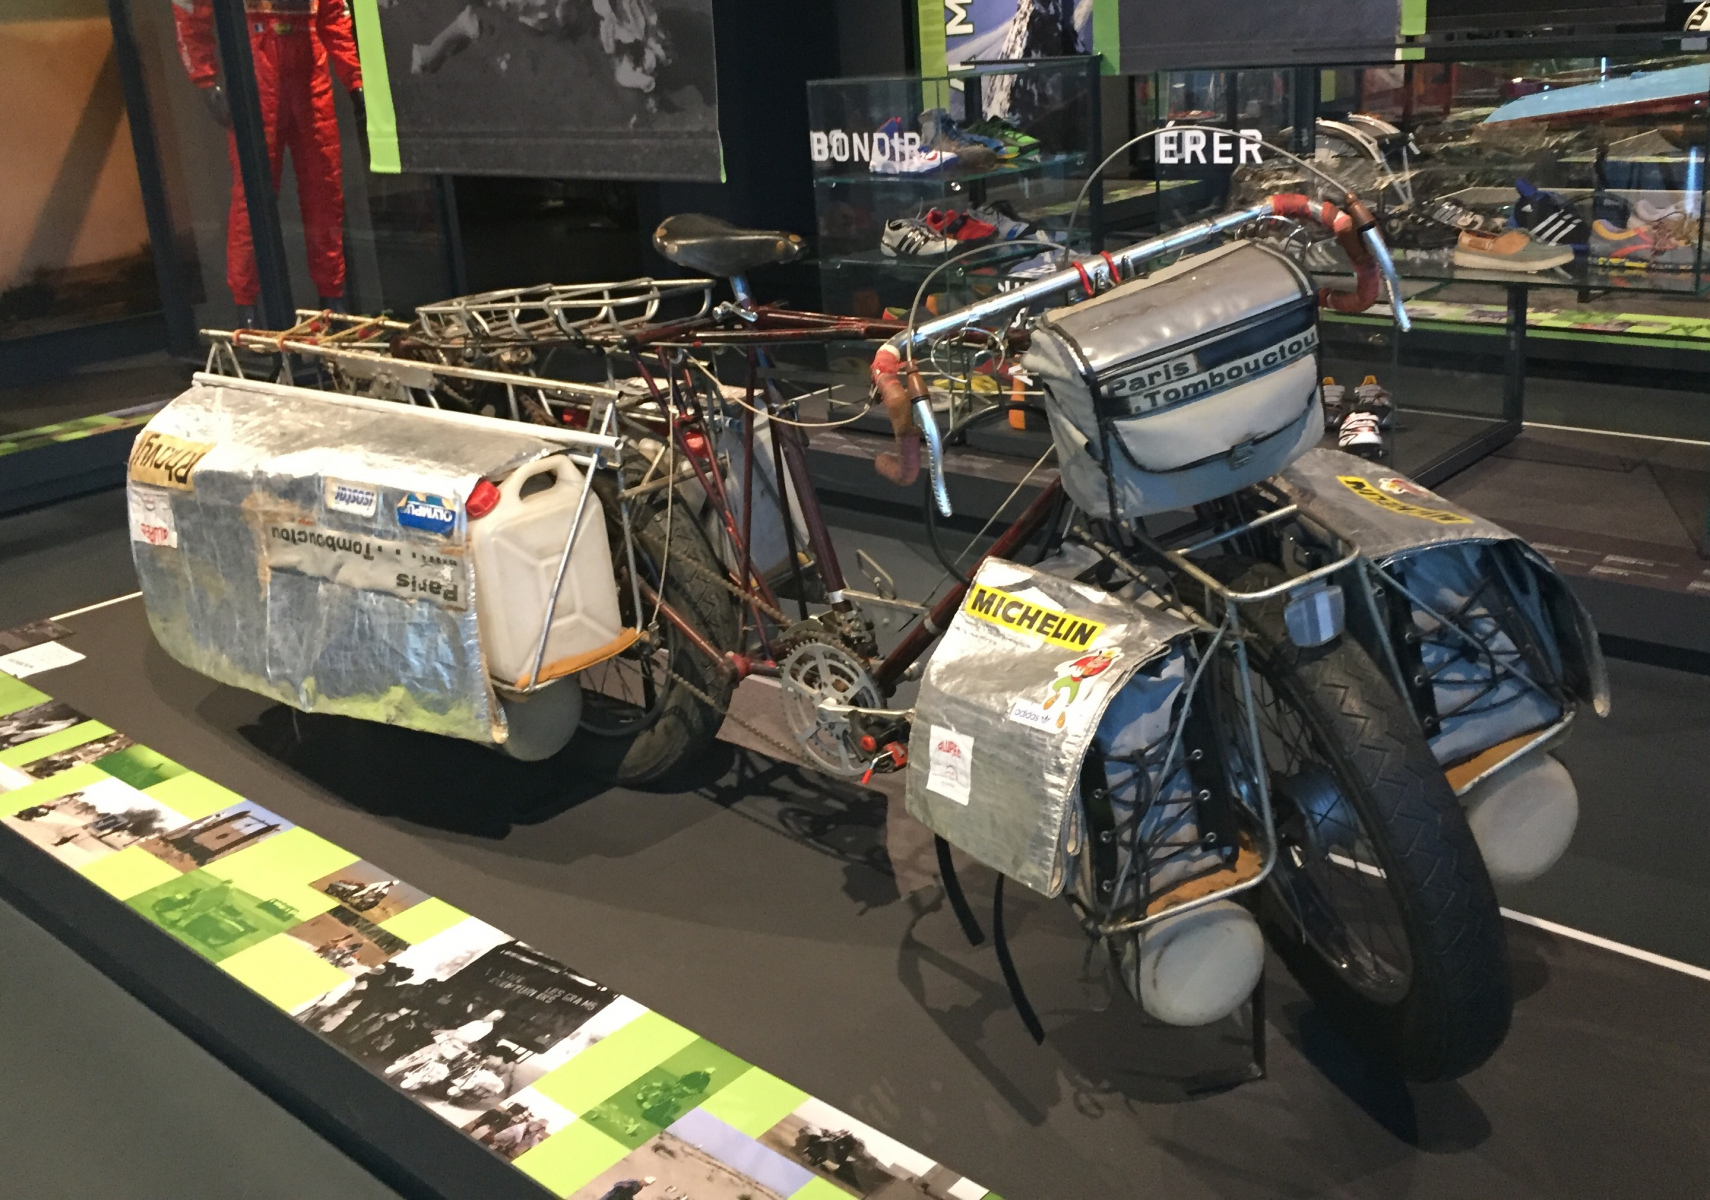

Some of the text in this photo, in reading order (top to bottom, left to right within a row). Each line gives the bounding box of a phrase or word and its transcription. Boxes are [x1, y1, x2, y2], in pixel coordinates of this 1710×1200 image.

[810, 131, 920, 162] BONDIR
[1106, 360, 1190, 397] Paris
[396, 573, 459, 602] Paris
[972, 588, 1098, 646] MICHELIN
[1014, 709, 1040, 722] adidas
